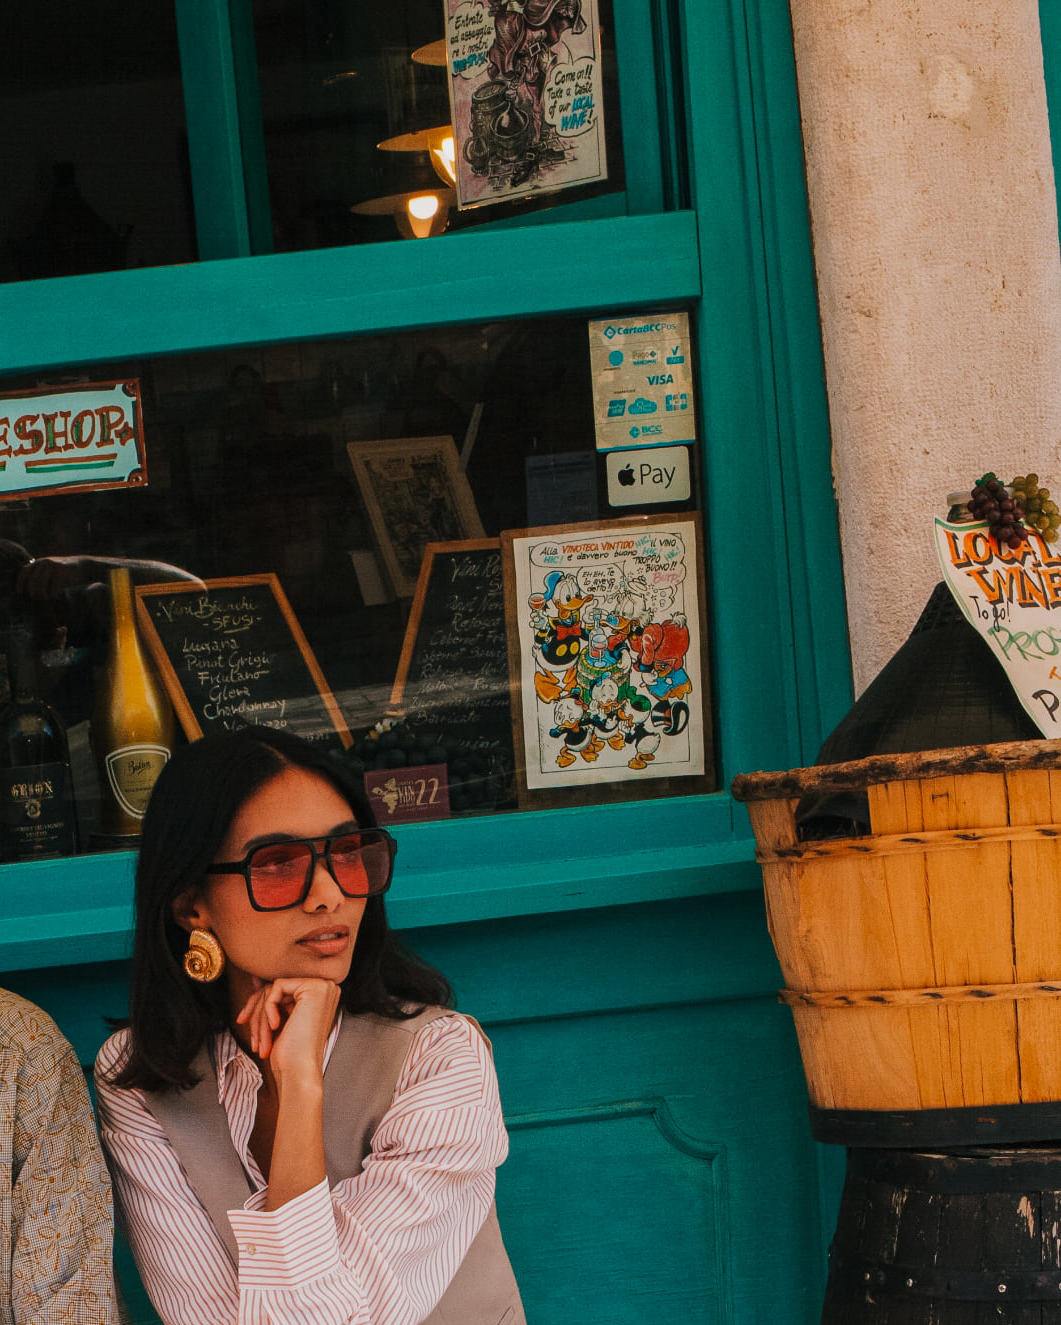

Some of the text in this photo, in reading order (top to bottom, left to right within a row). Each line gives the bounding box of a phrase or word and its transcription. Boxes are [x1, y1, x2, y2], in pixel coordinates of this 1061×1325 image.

[455, 11, 484, 30] Entrate
[555, 70, 576, 86] Come
[547, 87, 564, 100] Take
[575, 81, 593, 96] taste
[548, 100, 558, 119] of
[559, 102, 571, 113] our
[647, 373, 674, 386] VISA
[639, 463, 677, 489] Pay
[562, 544, 599, 554] VINOTECA
[659, 538, 677, 547] VINO
[577, 552, 609, 561] davvero
